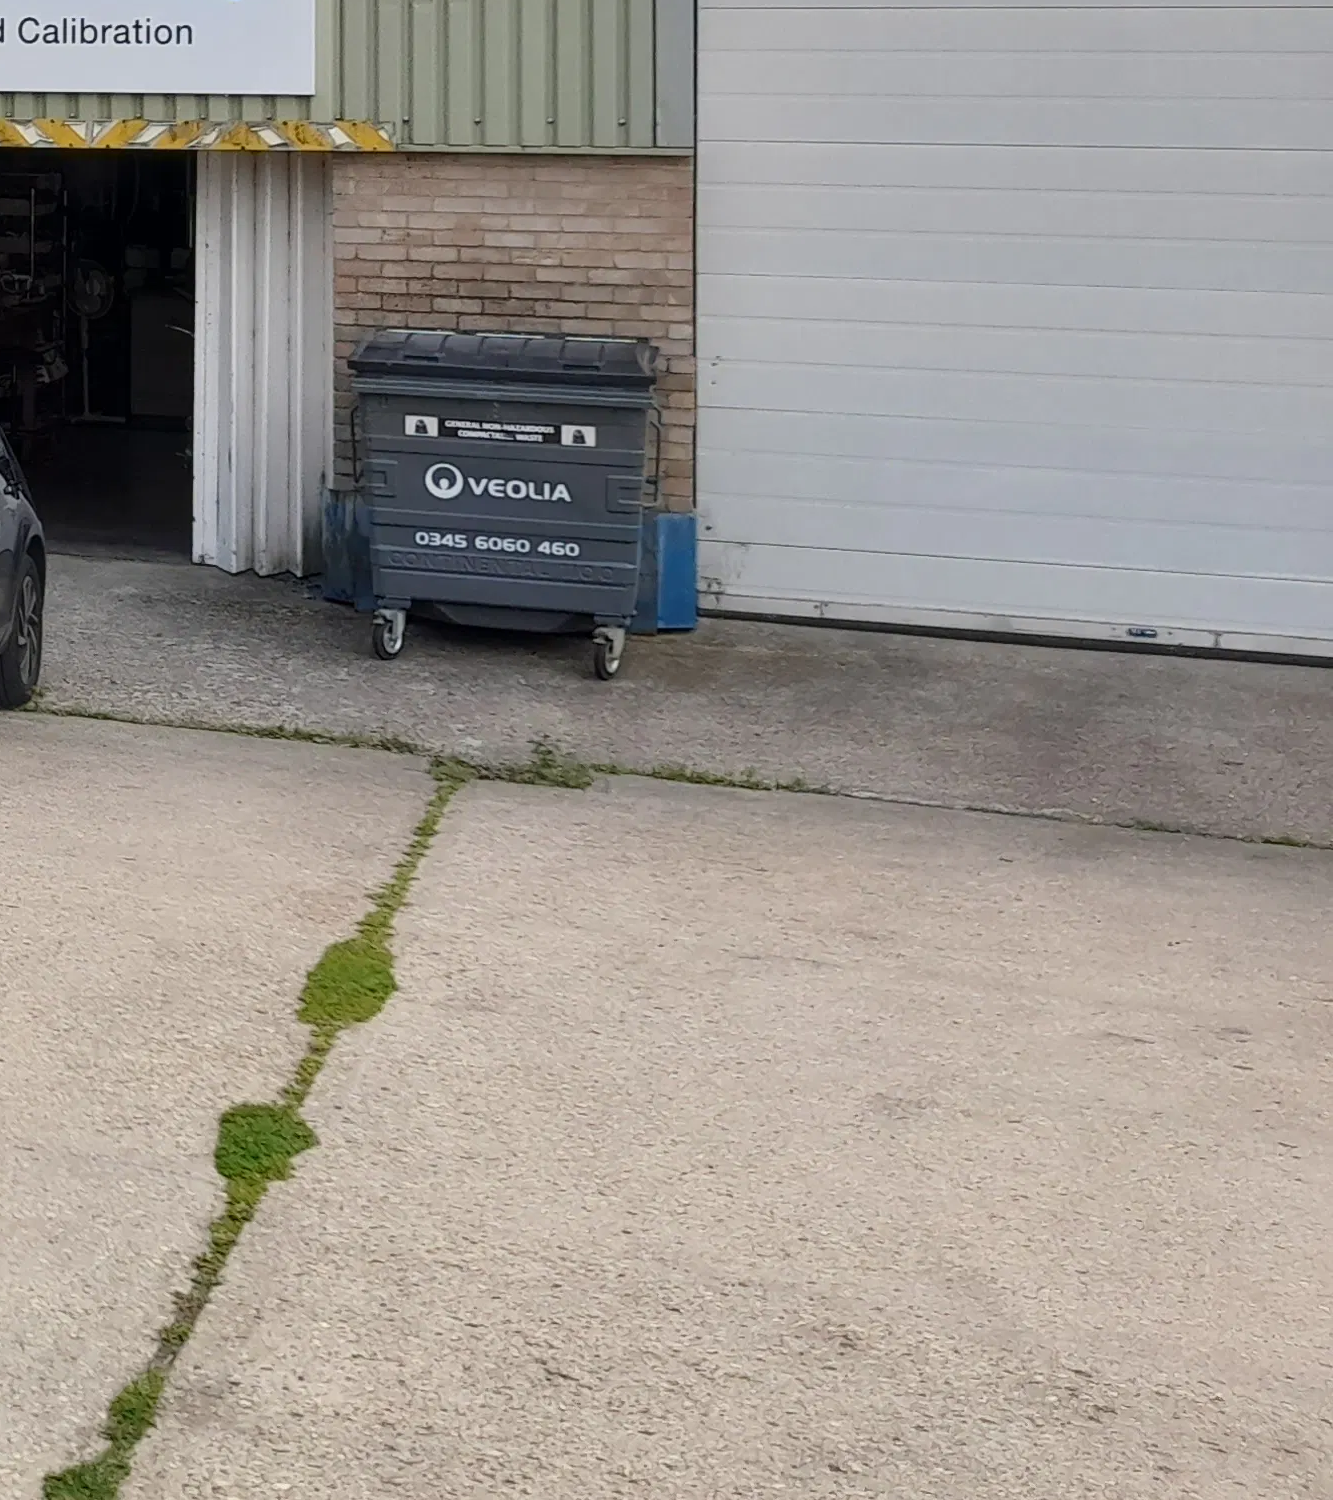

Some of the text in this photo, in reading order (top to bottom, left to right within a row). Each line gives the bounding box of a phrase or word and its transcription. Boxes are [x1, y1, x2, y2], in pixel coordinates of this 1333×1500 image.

[17, 16, 194, 45] Calibration
[467, 476, 572, 502] VEOLIA
[414, 531, 581, 557] 0345 6060 460
